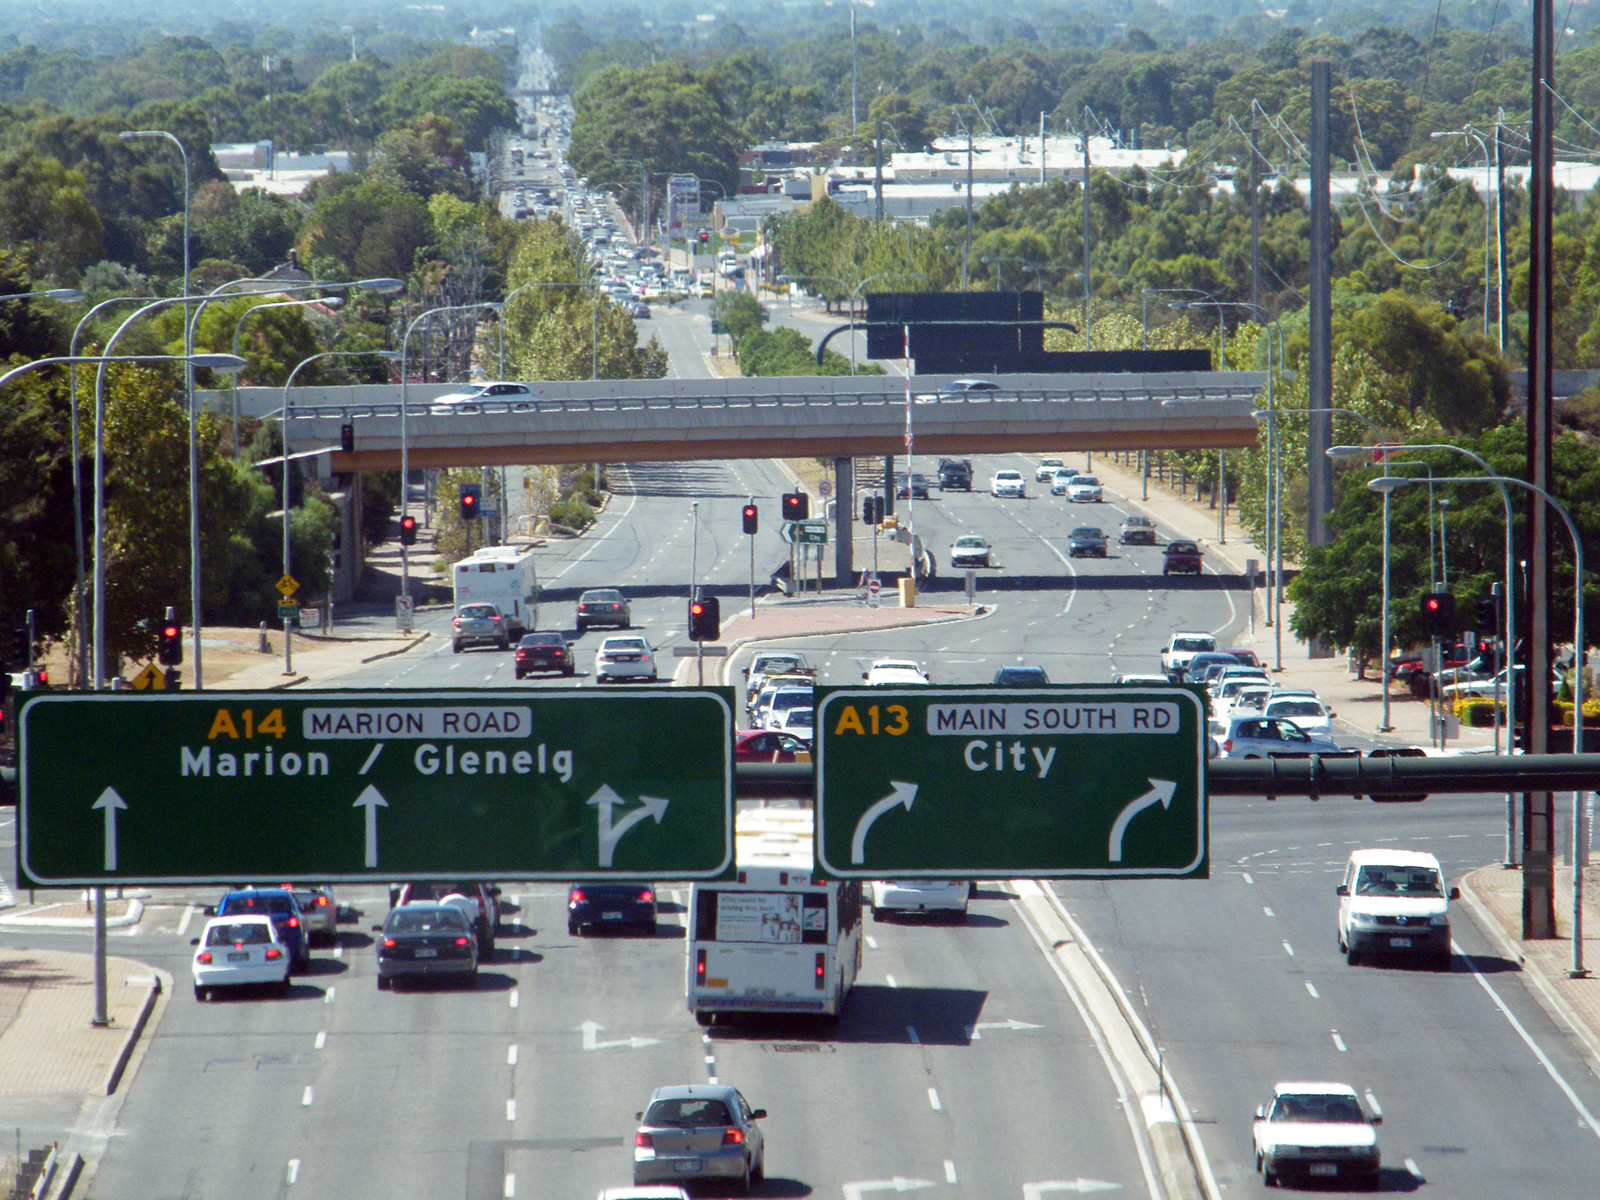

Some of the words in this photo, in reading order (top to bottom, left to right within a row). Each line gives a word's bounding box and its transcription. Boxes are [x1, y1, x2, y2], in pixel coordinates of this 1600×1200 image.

[208, 709, 286, 739] A14
[312, 713, 424, 734] MARION
[443, 712, 520, 733] ROAD
[834, 704, 910, 735] A13
[937, 708, 1007, 730] MAIN
[1023, 708, 1117, 730] SOUTH
[1133, 708, 1171, 730] RD
[181, 745, 329, 776] Marion
[414, 743, 573, 782] Glenelg
[964, 740, 1056, 778] City
